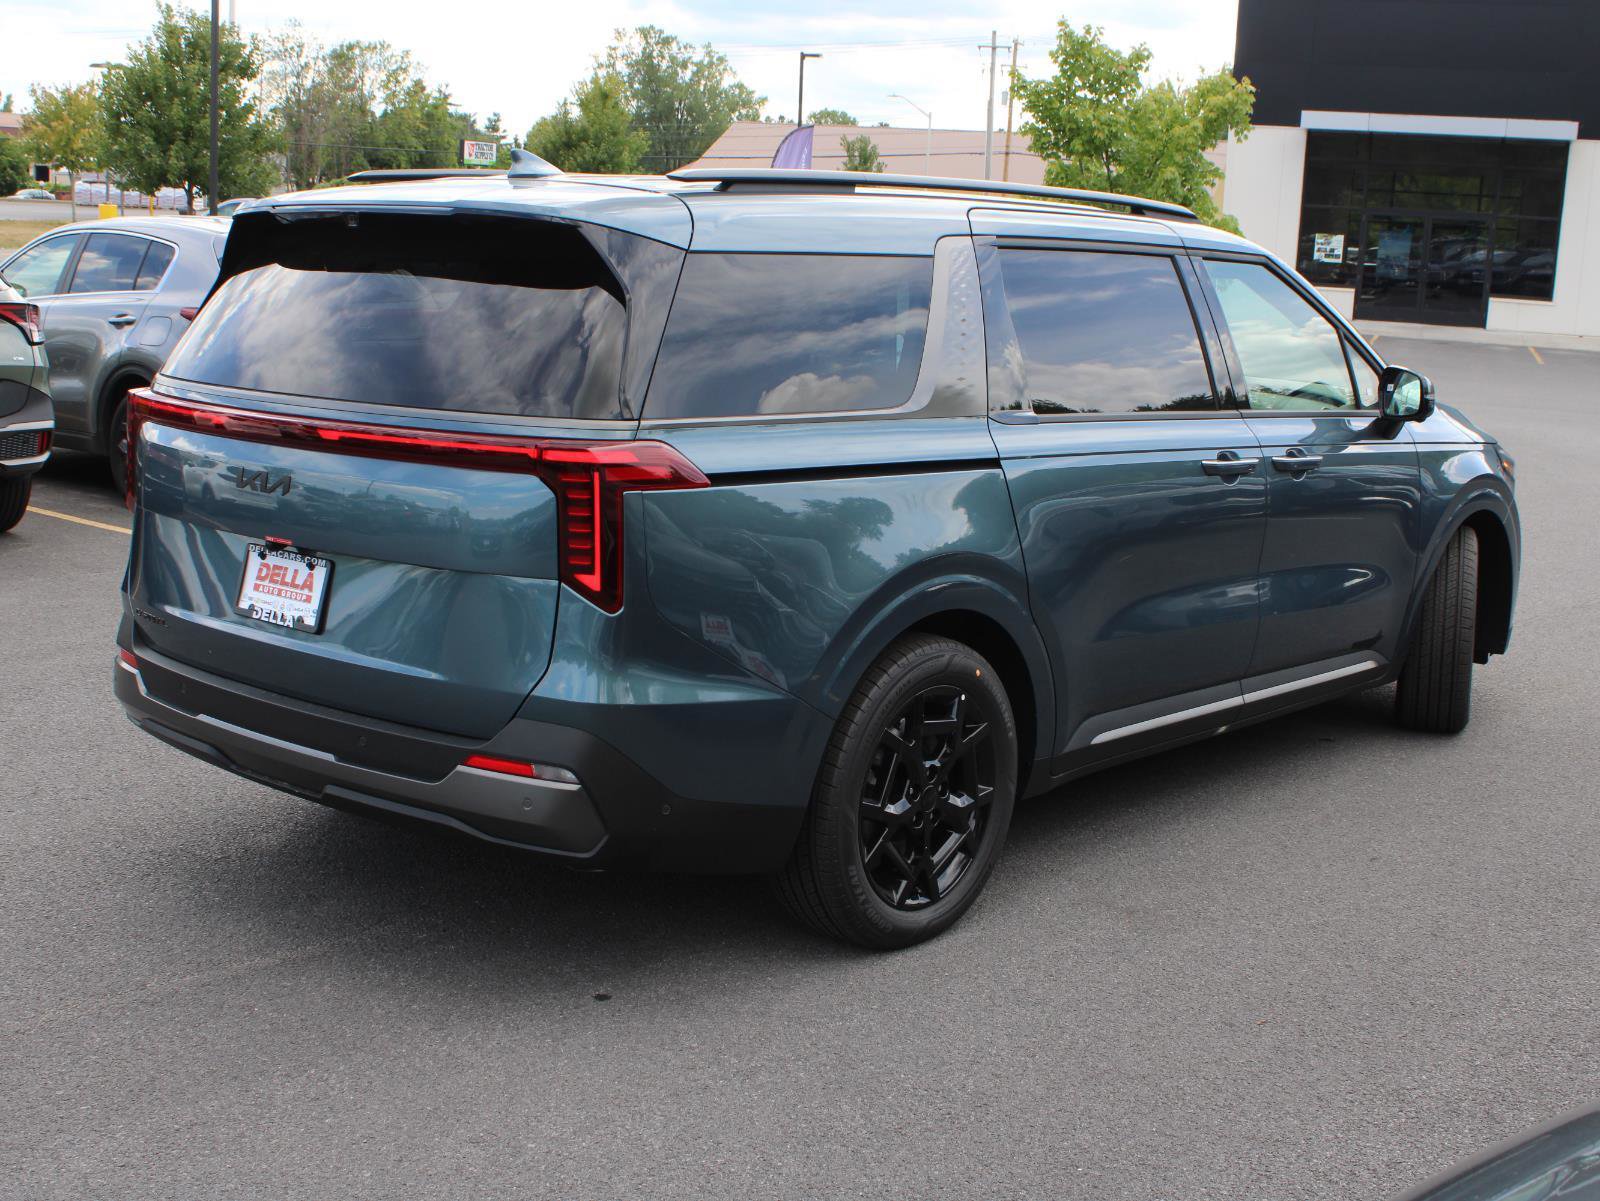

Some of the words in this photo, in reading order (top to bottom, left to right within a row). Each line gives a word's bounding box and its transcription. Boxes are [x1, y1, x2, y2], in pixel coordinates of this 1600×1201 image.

[475, 143, 493, 152] TRACTOR
[236, 465, 292, 497] KIA
[255, 562, 315, 593] DELLA
[259, 584, 279, 596] AUTO
[281, 589, 308, 602] GROUP
[252, 606, 295, 628] DELLA
